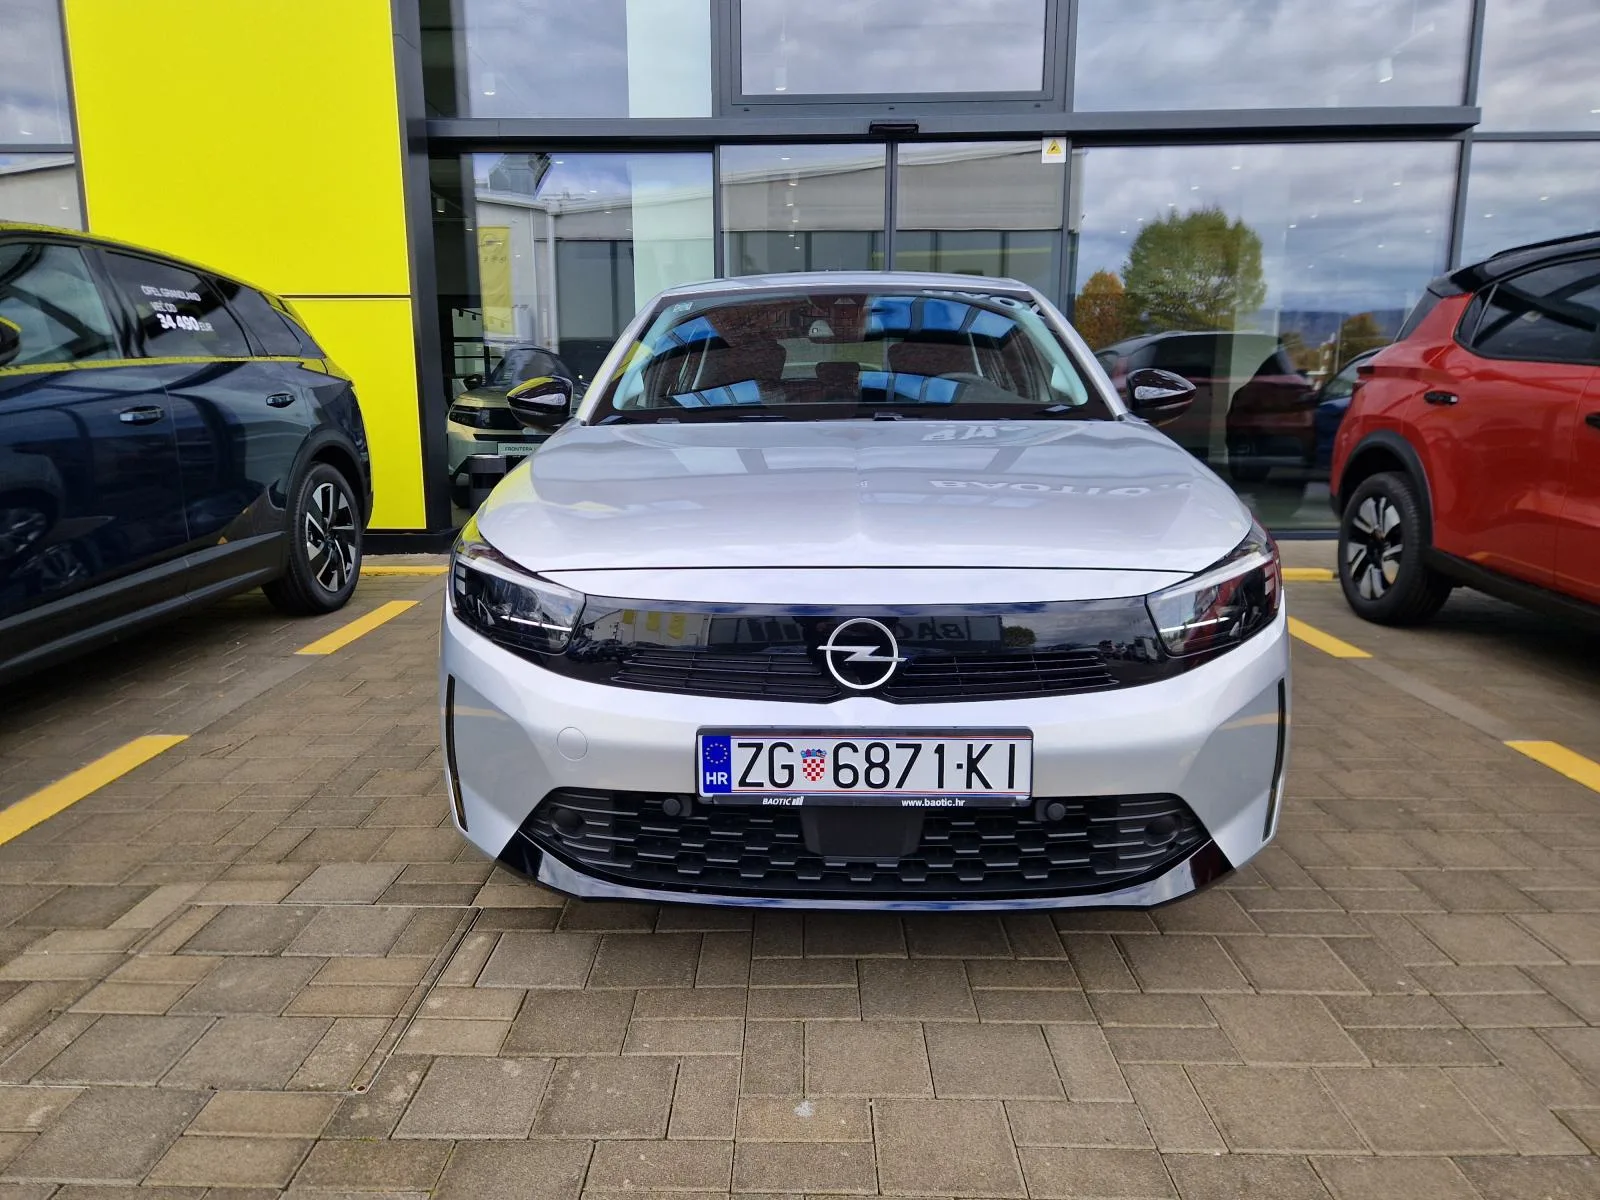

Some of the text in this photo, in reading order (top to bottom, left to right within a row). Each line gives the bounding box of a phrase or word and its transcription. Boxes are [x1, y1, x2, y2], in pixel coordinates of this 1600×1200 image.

[156, 313, 176, 329] 34
[176, 315, 200, 331] 490
[737, 741, 795, 789] ZG
[705, 771, 729, 785] HR
[901, 797, 966, 807] www.baotic.hr
